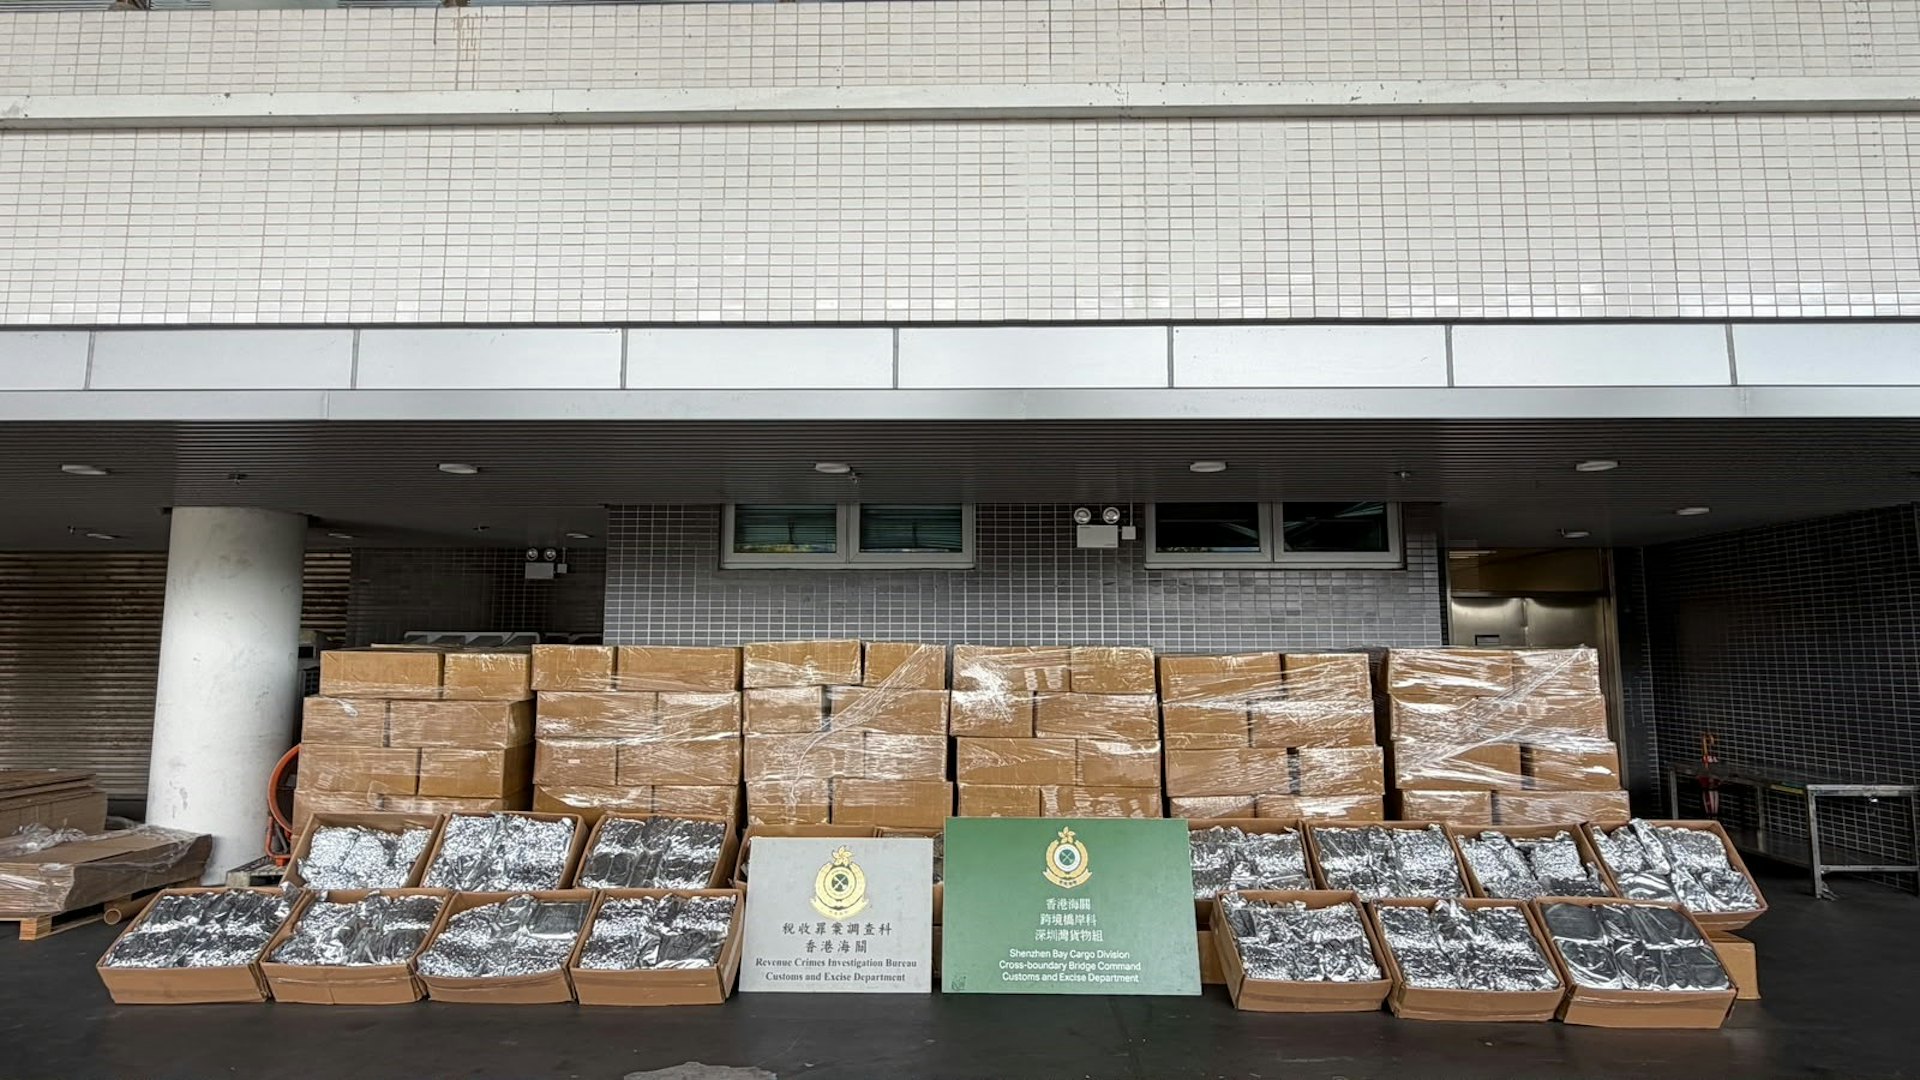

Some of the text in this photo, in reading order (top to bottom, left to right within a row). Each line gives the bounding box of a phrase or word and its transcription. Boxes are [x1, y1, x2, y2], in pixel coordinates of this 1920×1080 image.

[1046, 898, 1091, 910] 香港海關
[806, 939, 868, 953] 香港海關
[1009, 948, 1130, 960] Shenzhen Bay Cargo Division
[755, 958, 917, 968] Revenue Crimes Investigation Bureau
[999, 960, 1142, 972] Cross-boundary Bridge Command
[765, 971, 906, 983] Customs and Excise Department
[1002, 971, 1140, 983] Customs and Excise Department
